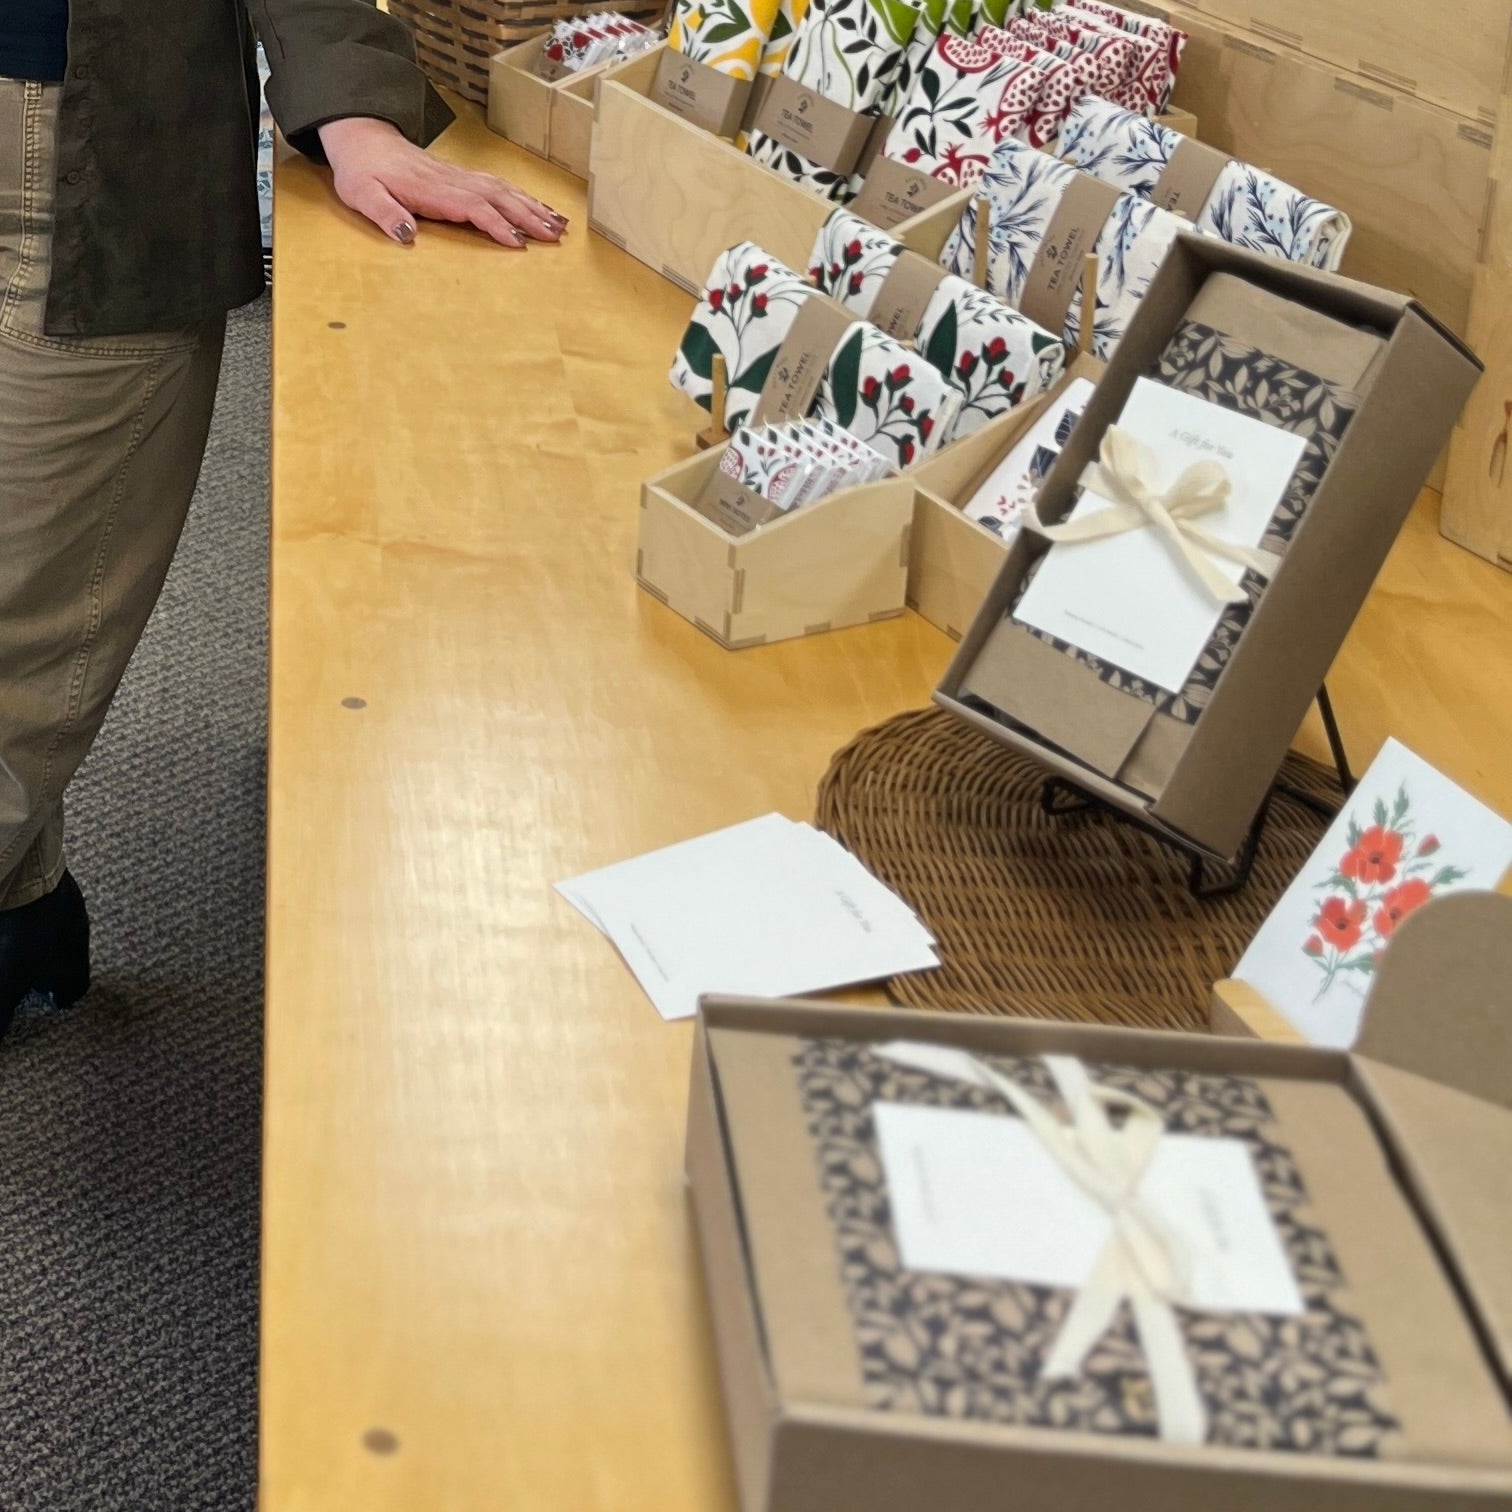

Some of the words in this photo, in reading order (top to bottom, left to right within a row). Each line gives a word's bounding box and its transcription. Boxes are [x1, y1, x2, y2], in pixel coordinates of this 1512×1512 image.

[781, 108, 793, 121] TEA
[793, 113, 814, 134] TOWEL
[884, 191, 900, 205] TEA
[1047, 267, 1061, 290] TEA
[1056, 226, 1081, 267] TOWEL
[778, 392, 793, 414] TEA
[789, 351, 811, 389] TOWEL
